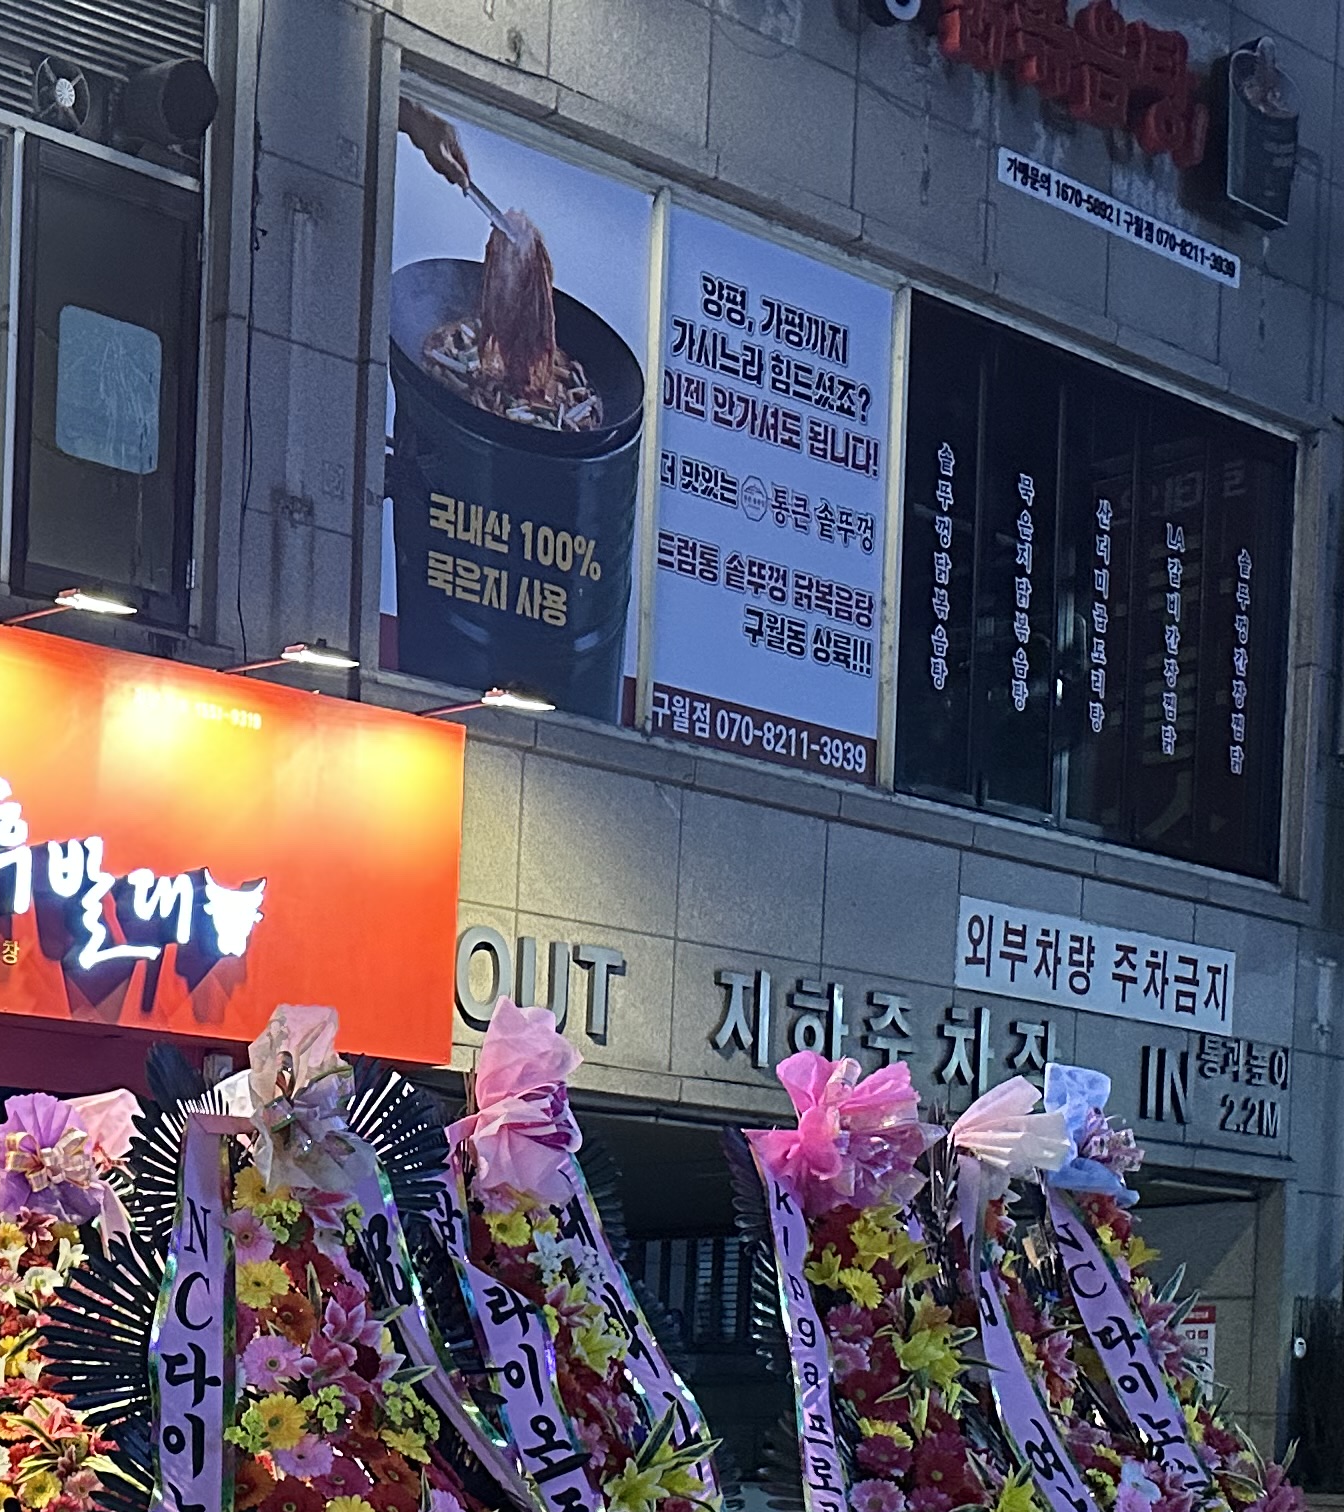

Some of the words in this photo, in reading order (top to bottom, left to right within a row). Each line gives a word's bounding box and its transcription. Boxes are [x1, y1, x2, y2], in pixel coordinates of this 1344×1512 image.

[1006, 156, 1052, 197] 가맹문의
[1123, 211, 1155, 244] 구월점
[701, 273, 755, 333] 양평,
[761, 297, 849, 366] 가평까지
[671, 318, 763, 386] 가시느라
[770, 353, 872, 424] 힘드셨죠?
[663, 369, 705, 418] 이젠
[712, 386, 802, 451] 안가셔도
[809, 418, 880, 478] 됩니다!
[429, 492, 511, 554] 국내산
[520, 520, 602, 581] 100%
[659, 453, 676, 486] 더
[680, 460, 739, 507] 맛있는
[770, 484, 811, 532] 통큰
[814, 500, 875, 553] 솥뚜껑
[427, 550, 508, 611] 묵은지
[515, 576, 568, 627] 사용
[657, 531, 720, 583] 드럼통
[724, 551, 788, 604] 솥뚜껑
[744, 606, 807, 659] 구월동
[812, 627, 872, 676] 상륙!!!
[651, 690, 711, 738] 구월점
[715, 708, 867, 773] 070-8211-3939
[965, 913, 1095, 996] 외부차량
[1111, 942, 1229, 1022] 주차금지
[455, 925, 625, 1046] OUT
[1139, 1045, 1190, 1126] IN
[1199, 1033, 1289, 1090] 통과높이
[1218, 1093, 1281, 1139] 2.2M
